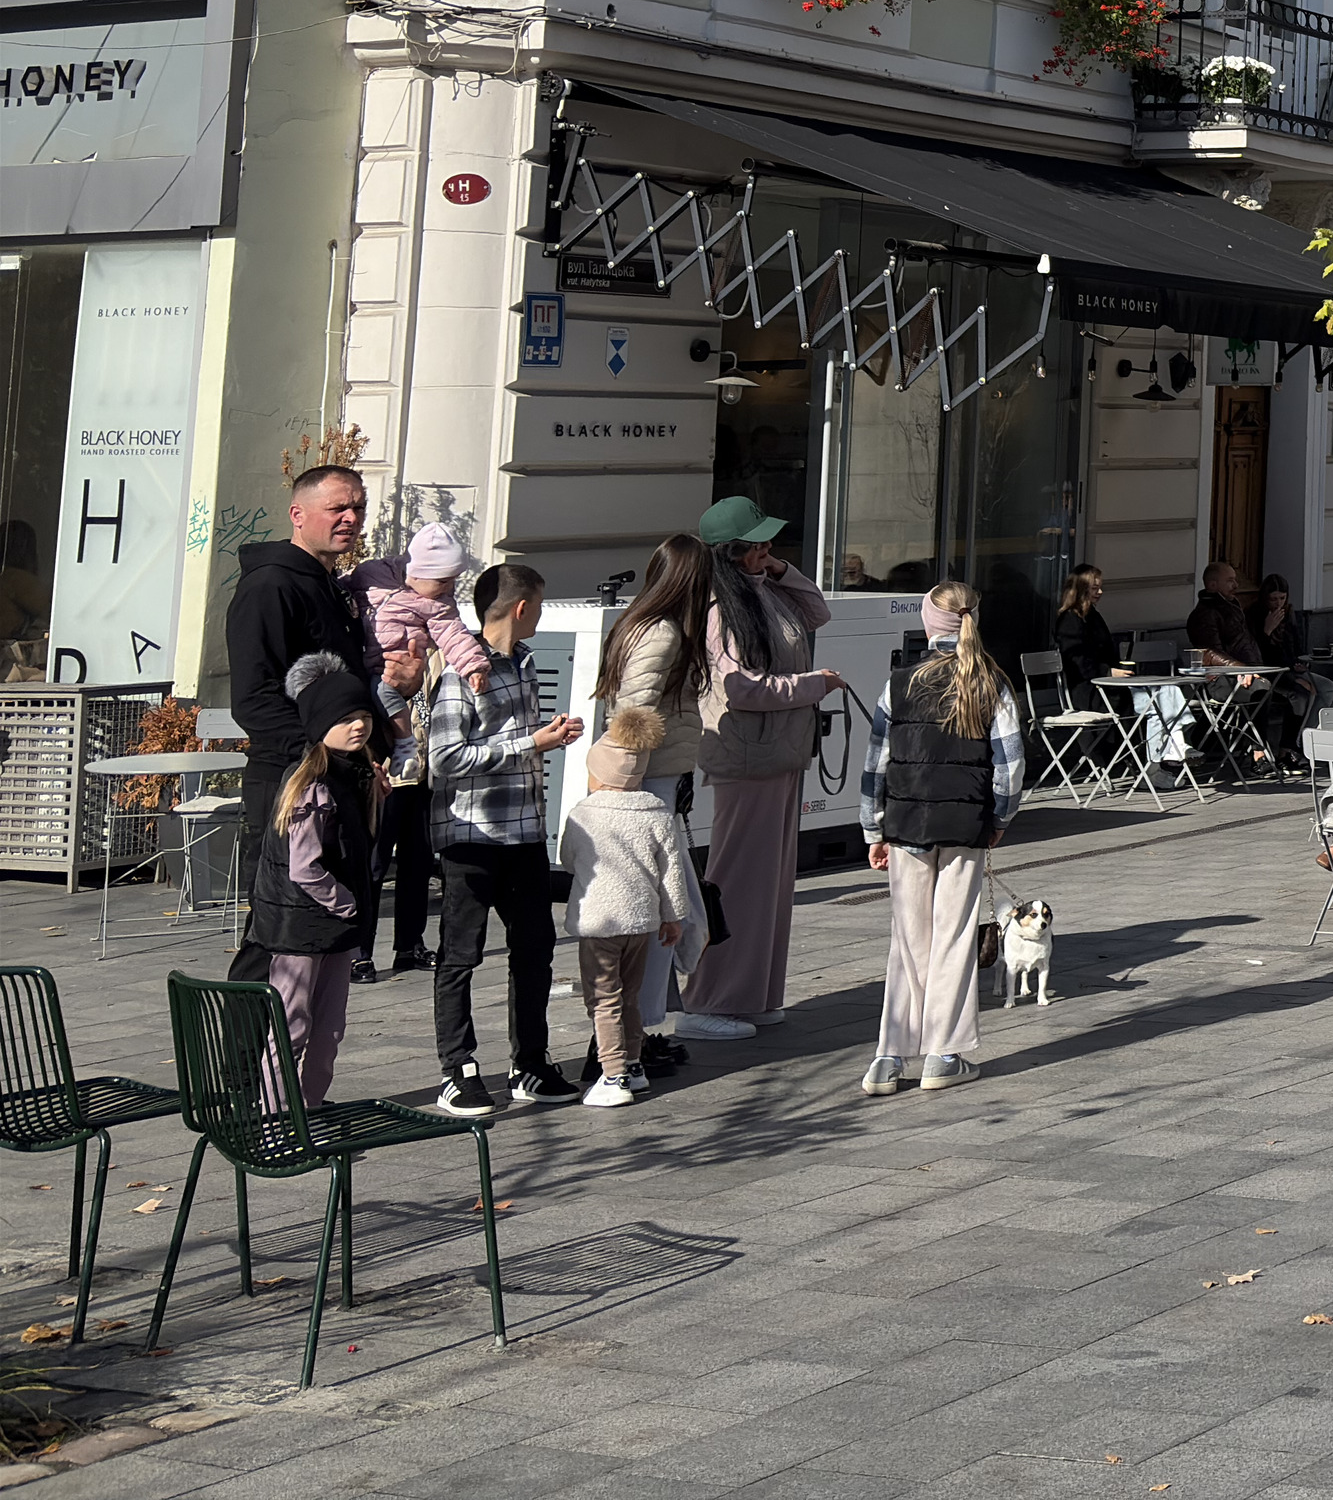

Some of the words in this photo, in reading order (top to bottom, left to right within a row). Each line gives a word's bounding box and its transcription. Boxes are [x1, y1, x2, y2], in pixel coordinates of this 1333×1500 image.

[567, 261, 586, 274] вул.
[1077, 294, 1115, 309] BLACK
[1121, 298, 1158, 314] HONEY
[97, 308, 136, 318] BLACK
[144, 306, 189, 316] HONEY
[533, 305, 556, 323] ПГ
[80, 430, 125, 445] BLACK
[129, 430, 182, 446] HONEY
[554, 424, 612, 437] BLACK
[621, 424, 677, 438] HONEY
[77, 478, 126, 563] H
[890, 600, 922, 614] Викли
